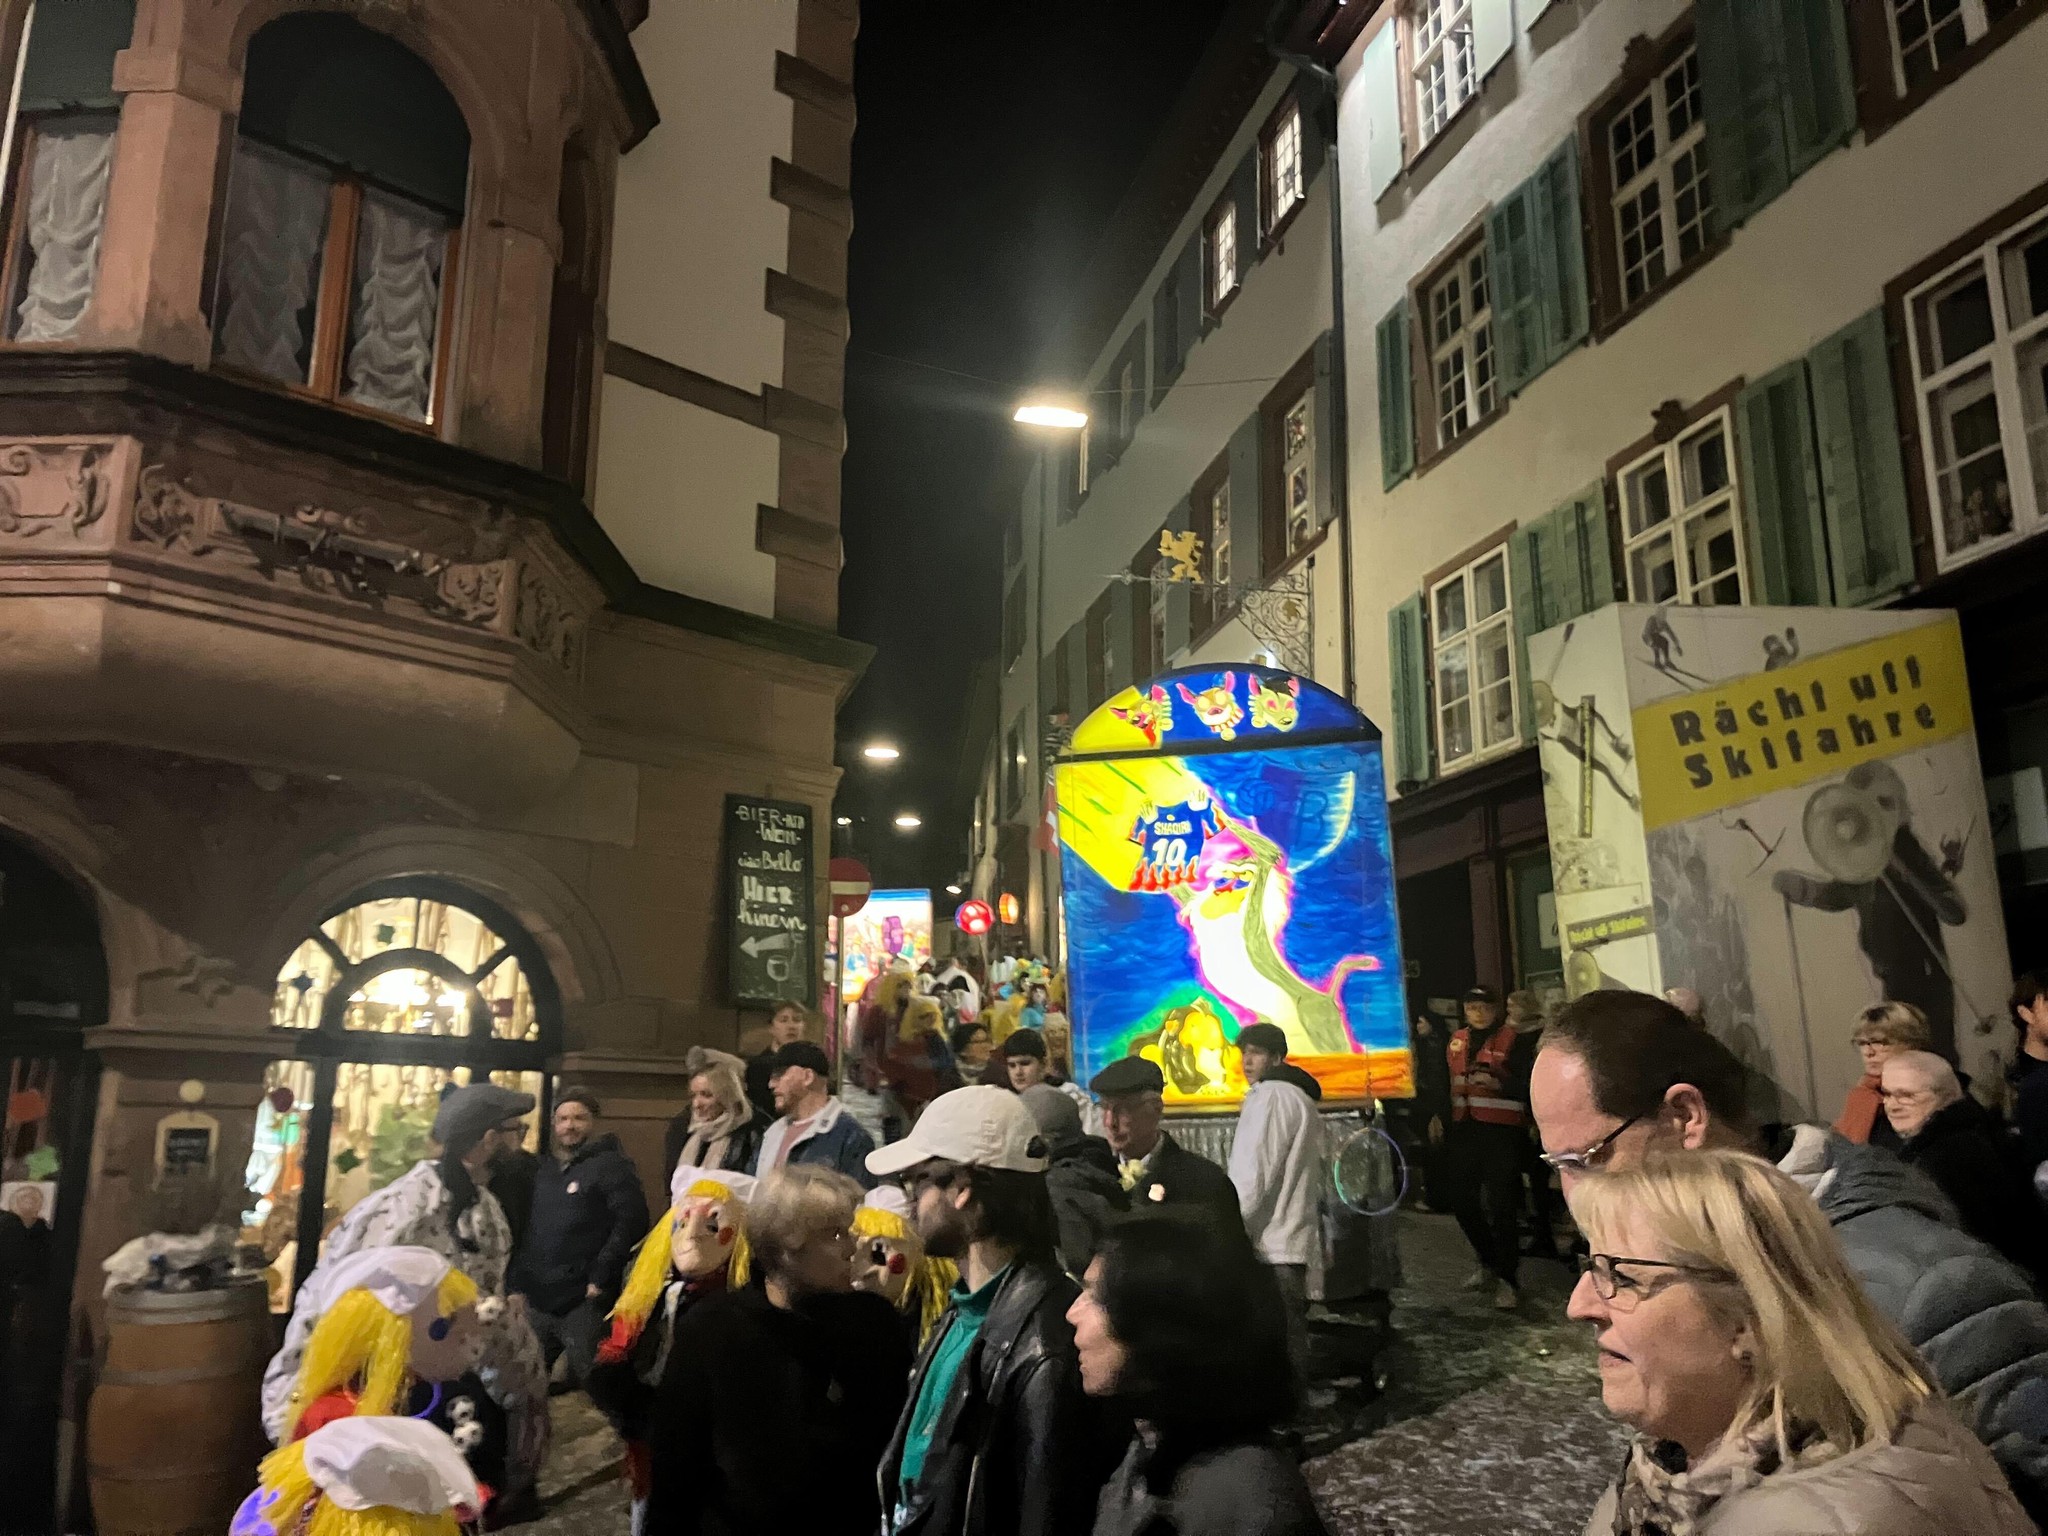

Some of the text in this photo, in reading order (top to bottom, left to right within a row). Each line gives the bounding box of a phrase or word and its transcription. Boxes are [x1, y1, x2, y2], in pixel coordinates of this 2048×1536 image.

[1670, 680, 1827, 747] Rächt
[1683, 702, 1936, 789] Skifahre
[1152, 838, 1187, 866] 10
